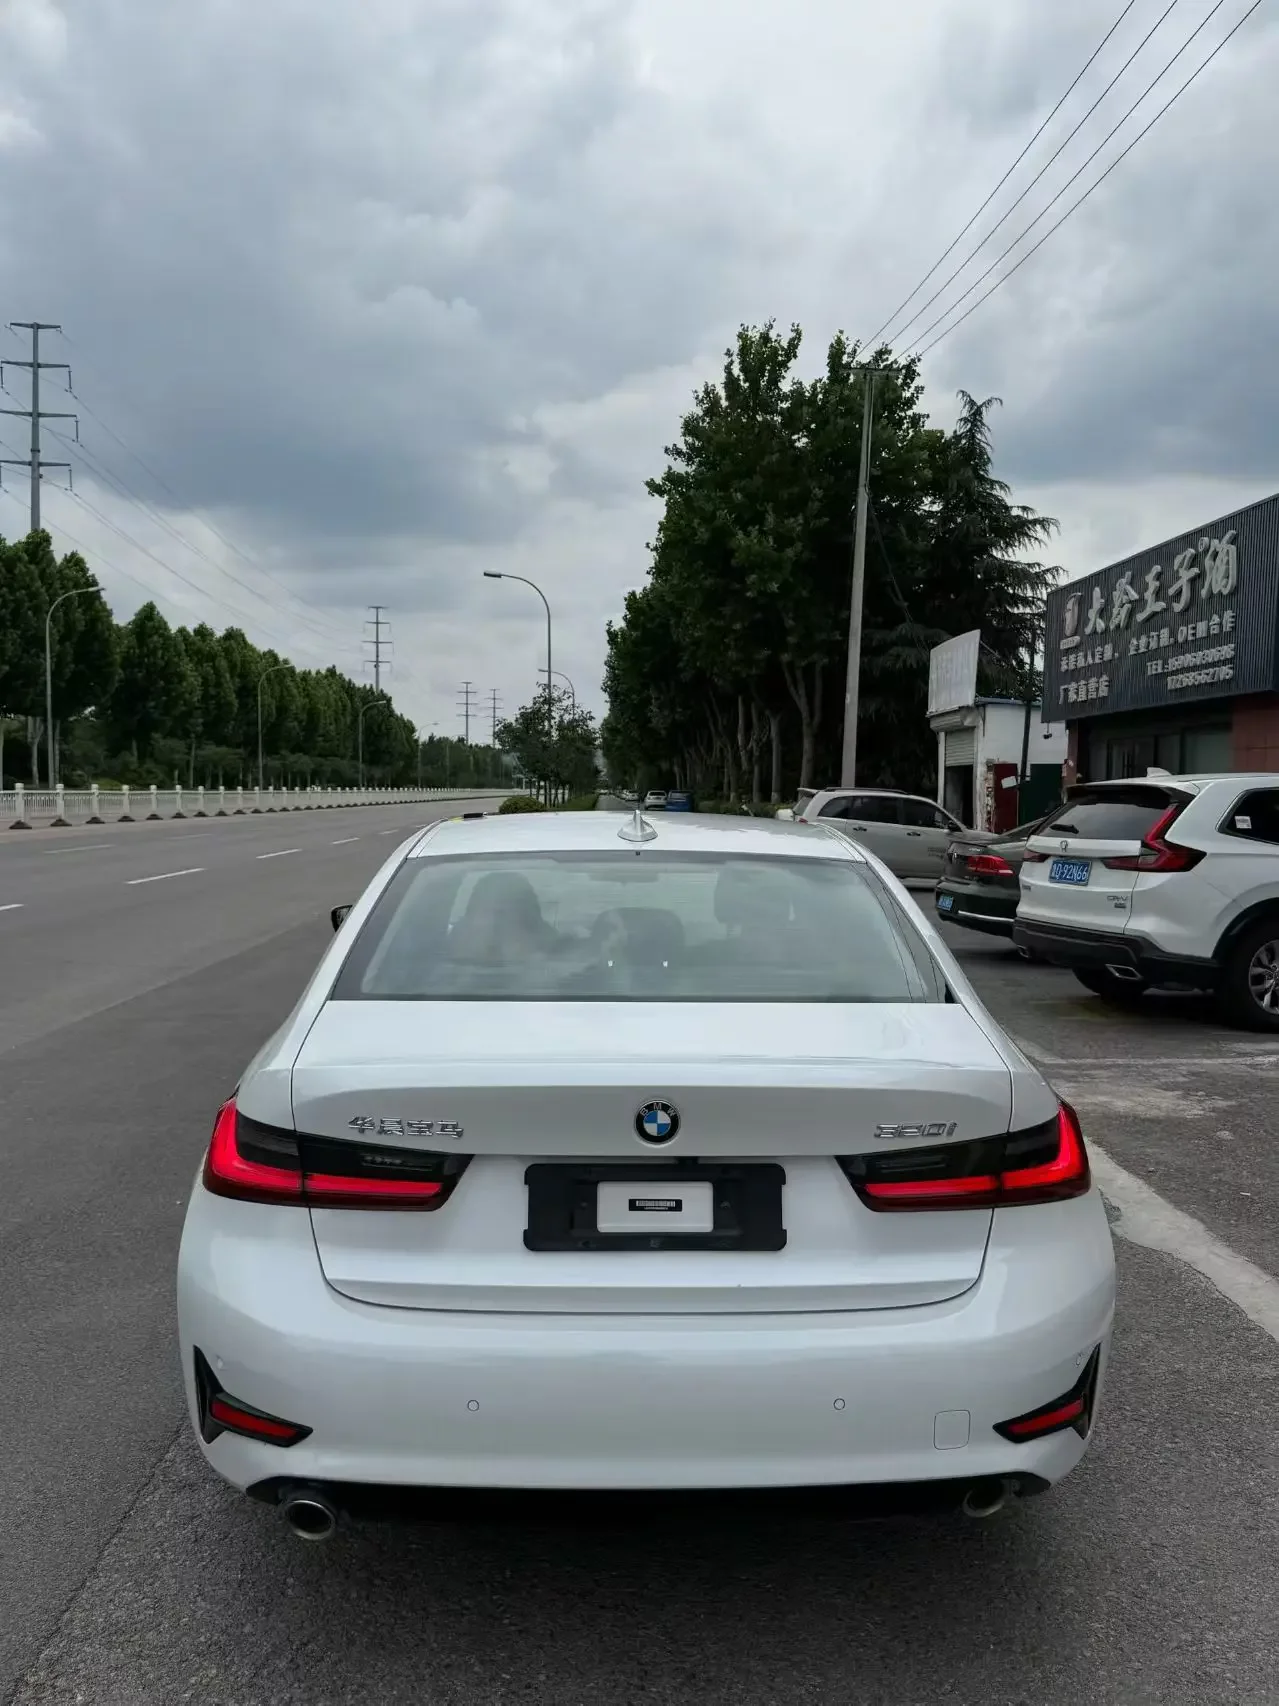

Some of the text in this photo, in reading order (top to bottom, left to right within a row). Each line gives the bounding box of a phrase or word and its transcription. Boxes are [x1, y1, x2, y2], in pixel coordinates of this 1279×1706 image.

[640, 1103, 676, 1116] BMW
[348, 1116, 464, 1139] 华晨宝马
